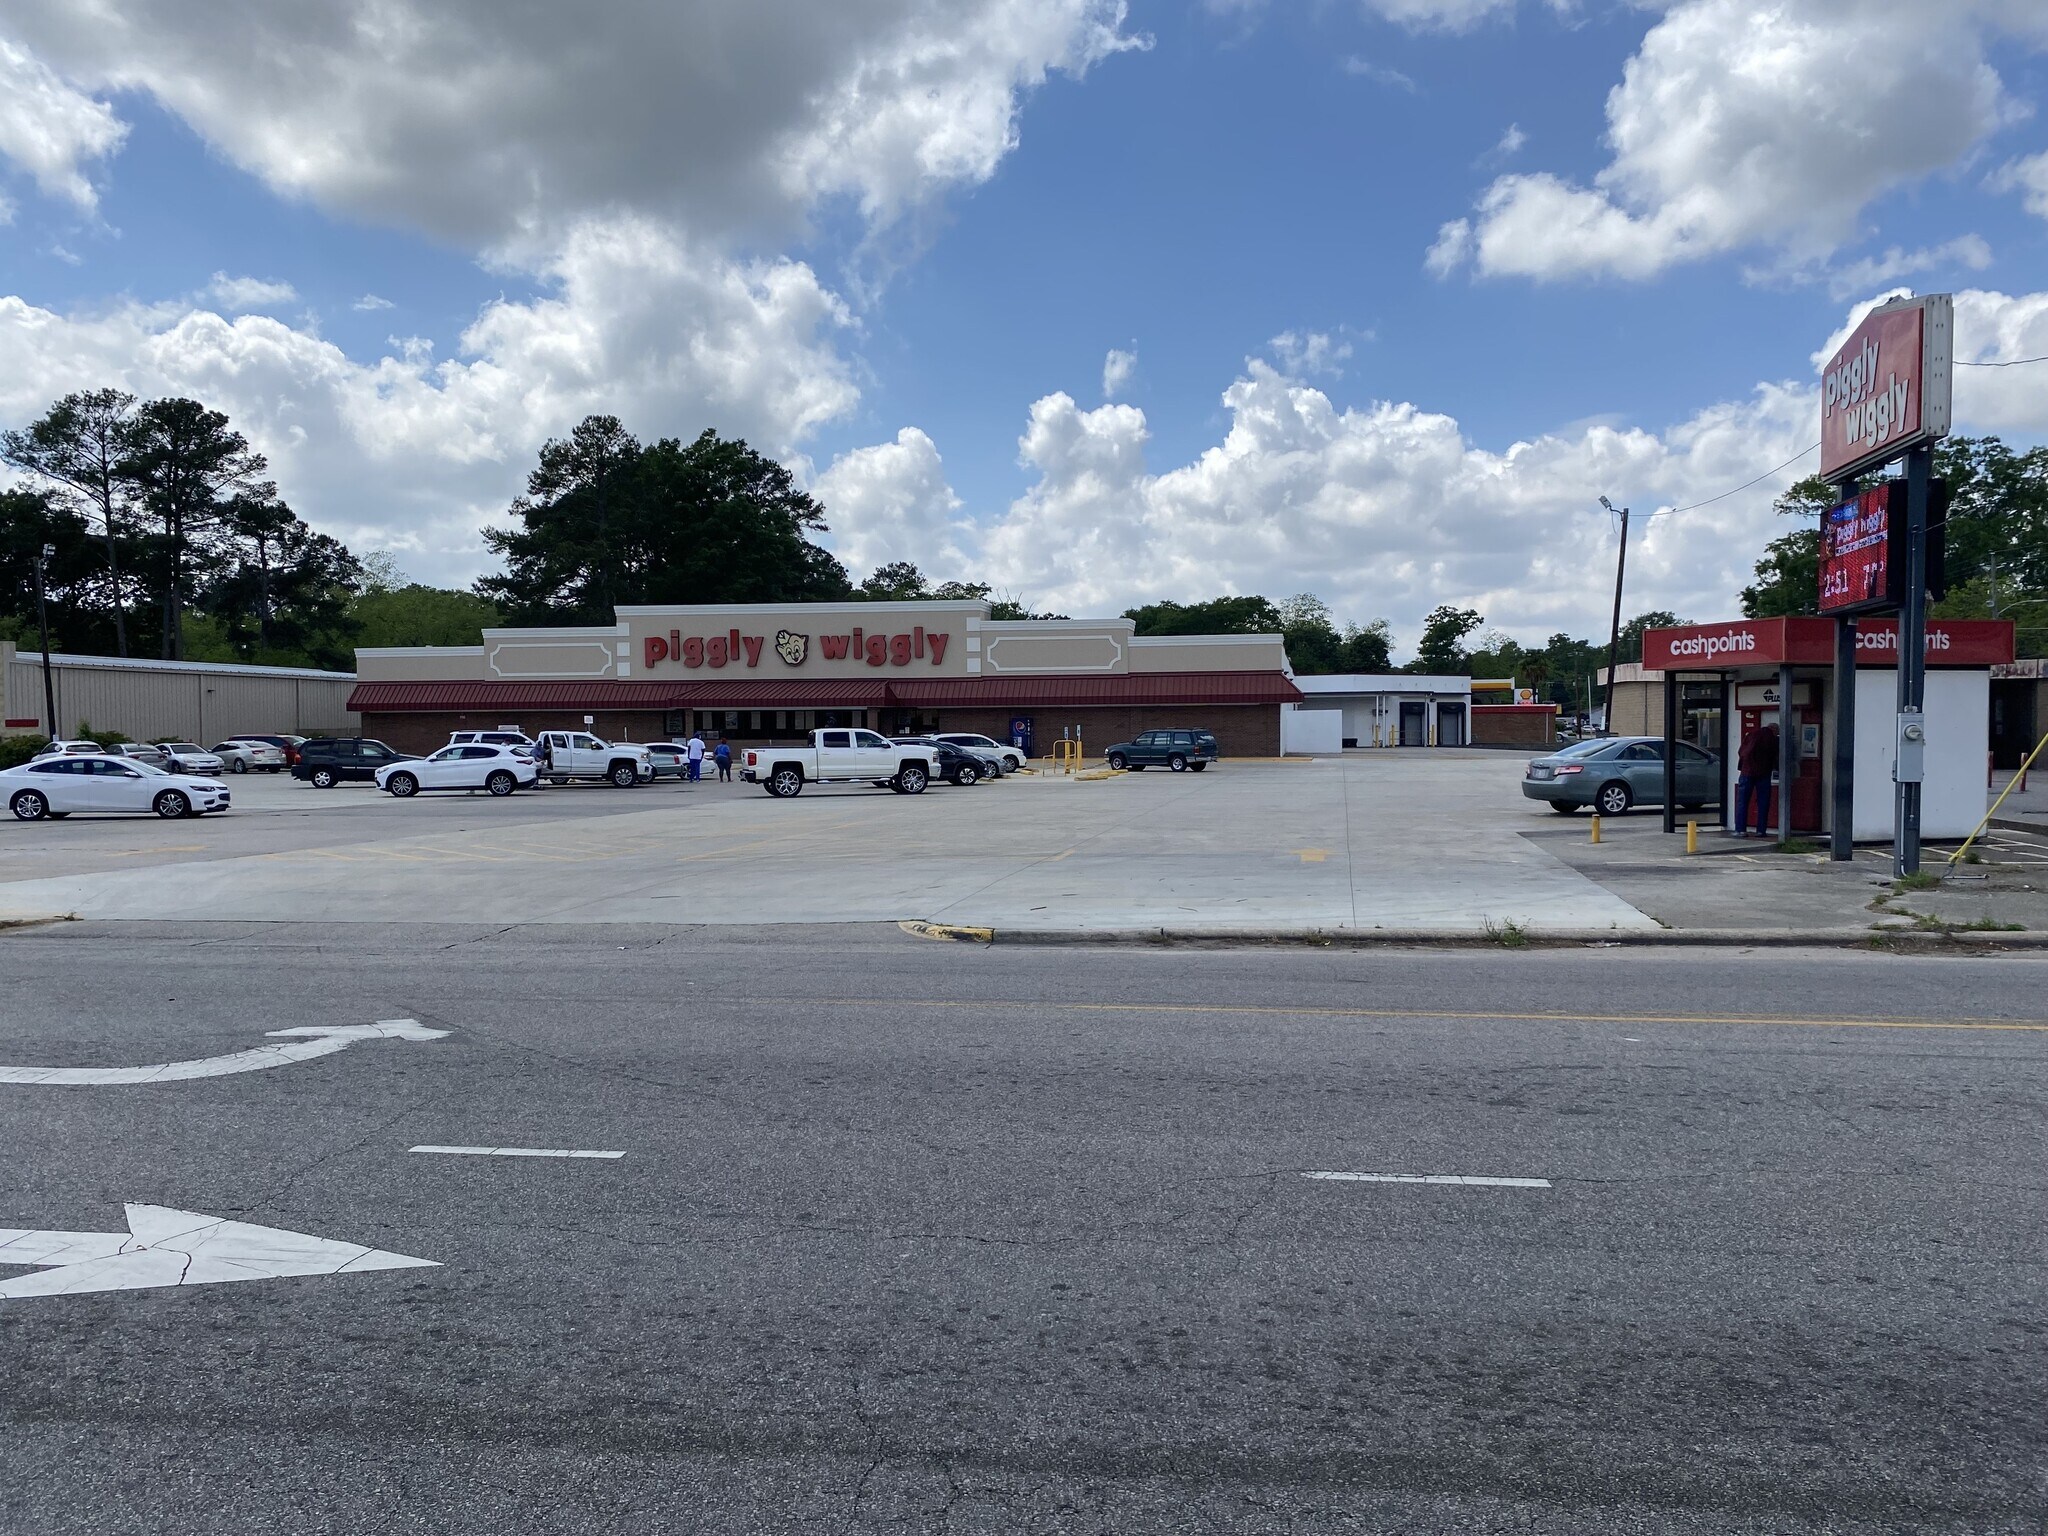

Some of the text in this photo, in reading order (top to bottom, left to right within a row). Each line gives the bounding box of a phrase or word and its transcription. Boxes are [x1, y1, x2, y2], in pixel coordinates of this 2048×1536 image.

[1826, 336, 1880, 418] piggly
[1846, 372, 1910, 448] wiggly
[1824, 568, 1849, 598] 2:51
[645, 627, 950, 668] piggly wiggly
[1670, 629, 1756, 660] cashpoints
[1855, 628, 1950, 655] cashnts
